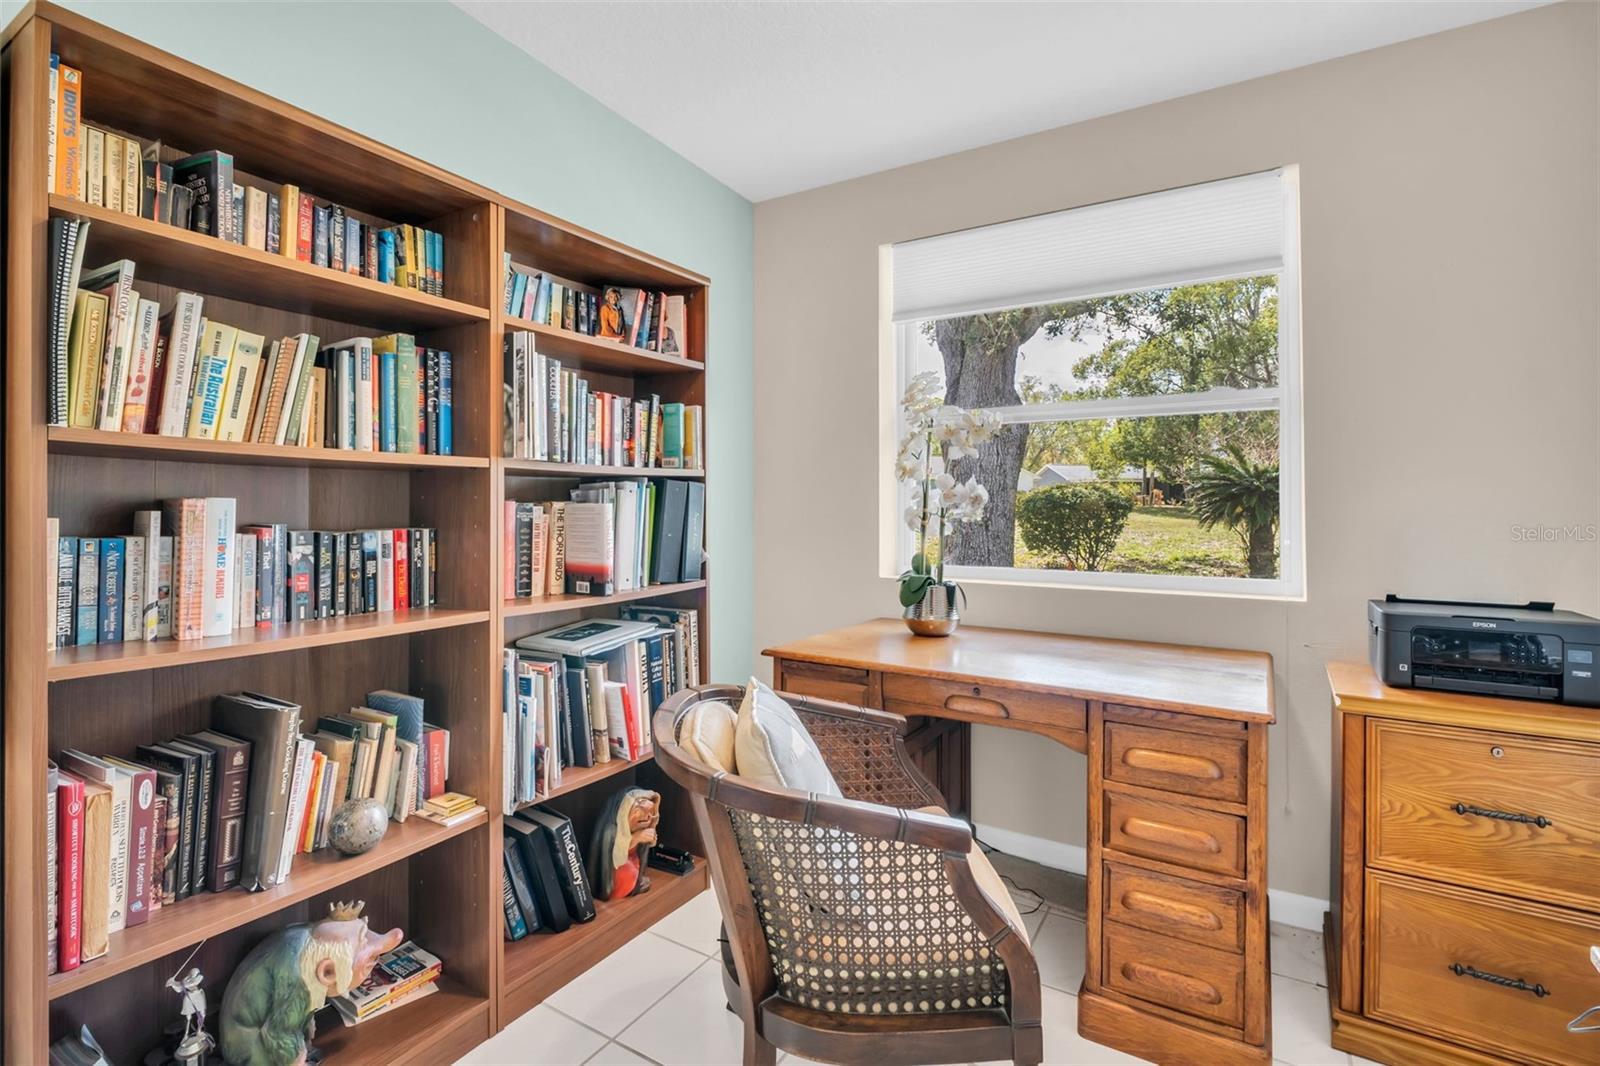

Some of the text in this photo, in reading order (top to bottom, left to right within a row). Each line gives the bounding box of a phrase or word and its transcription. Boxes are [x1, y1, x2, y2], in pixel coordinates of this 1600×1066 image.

[63, 90, 78, 138] IDIOT'S
[121, 274, 132, 295] IRISH
[200, 358, 229, 426] The Australian
[549, 367, 560, 400] COULTER
[262, 551, 271, 570] Tibet
[554, 508, 565, 581] THE THORN BIRDS
[105, 552, 120, 595] NORA ROBERTS
[215, 538, 227, 599] HOME REMEDIES
[57, 554, 73, 636] ANN RULE BITTER HARVEST
[282, 746, 293, 772] Cooking
[280, 773, 290, 795] Course
[70, 818, 79, 851] SHORTCUT
[560, 825, 570, 848] The
[70, 852, 78, 881] COOKING
[136, 862, 147, 897] Appetizers
[564, 844, 584, 886] Century
